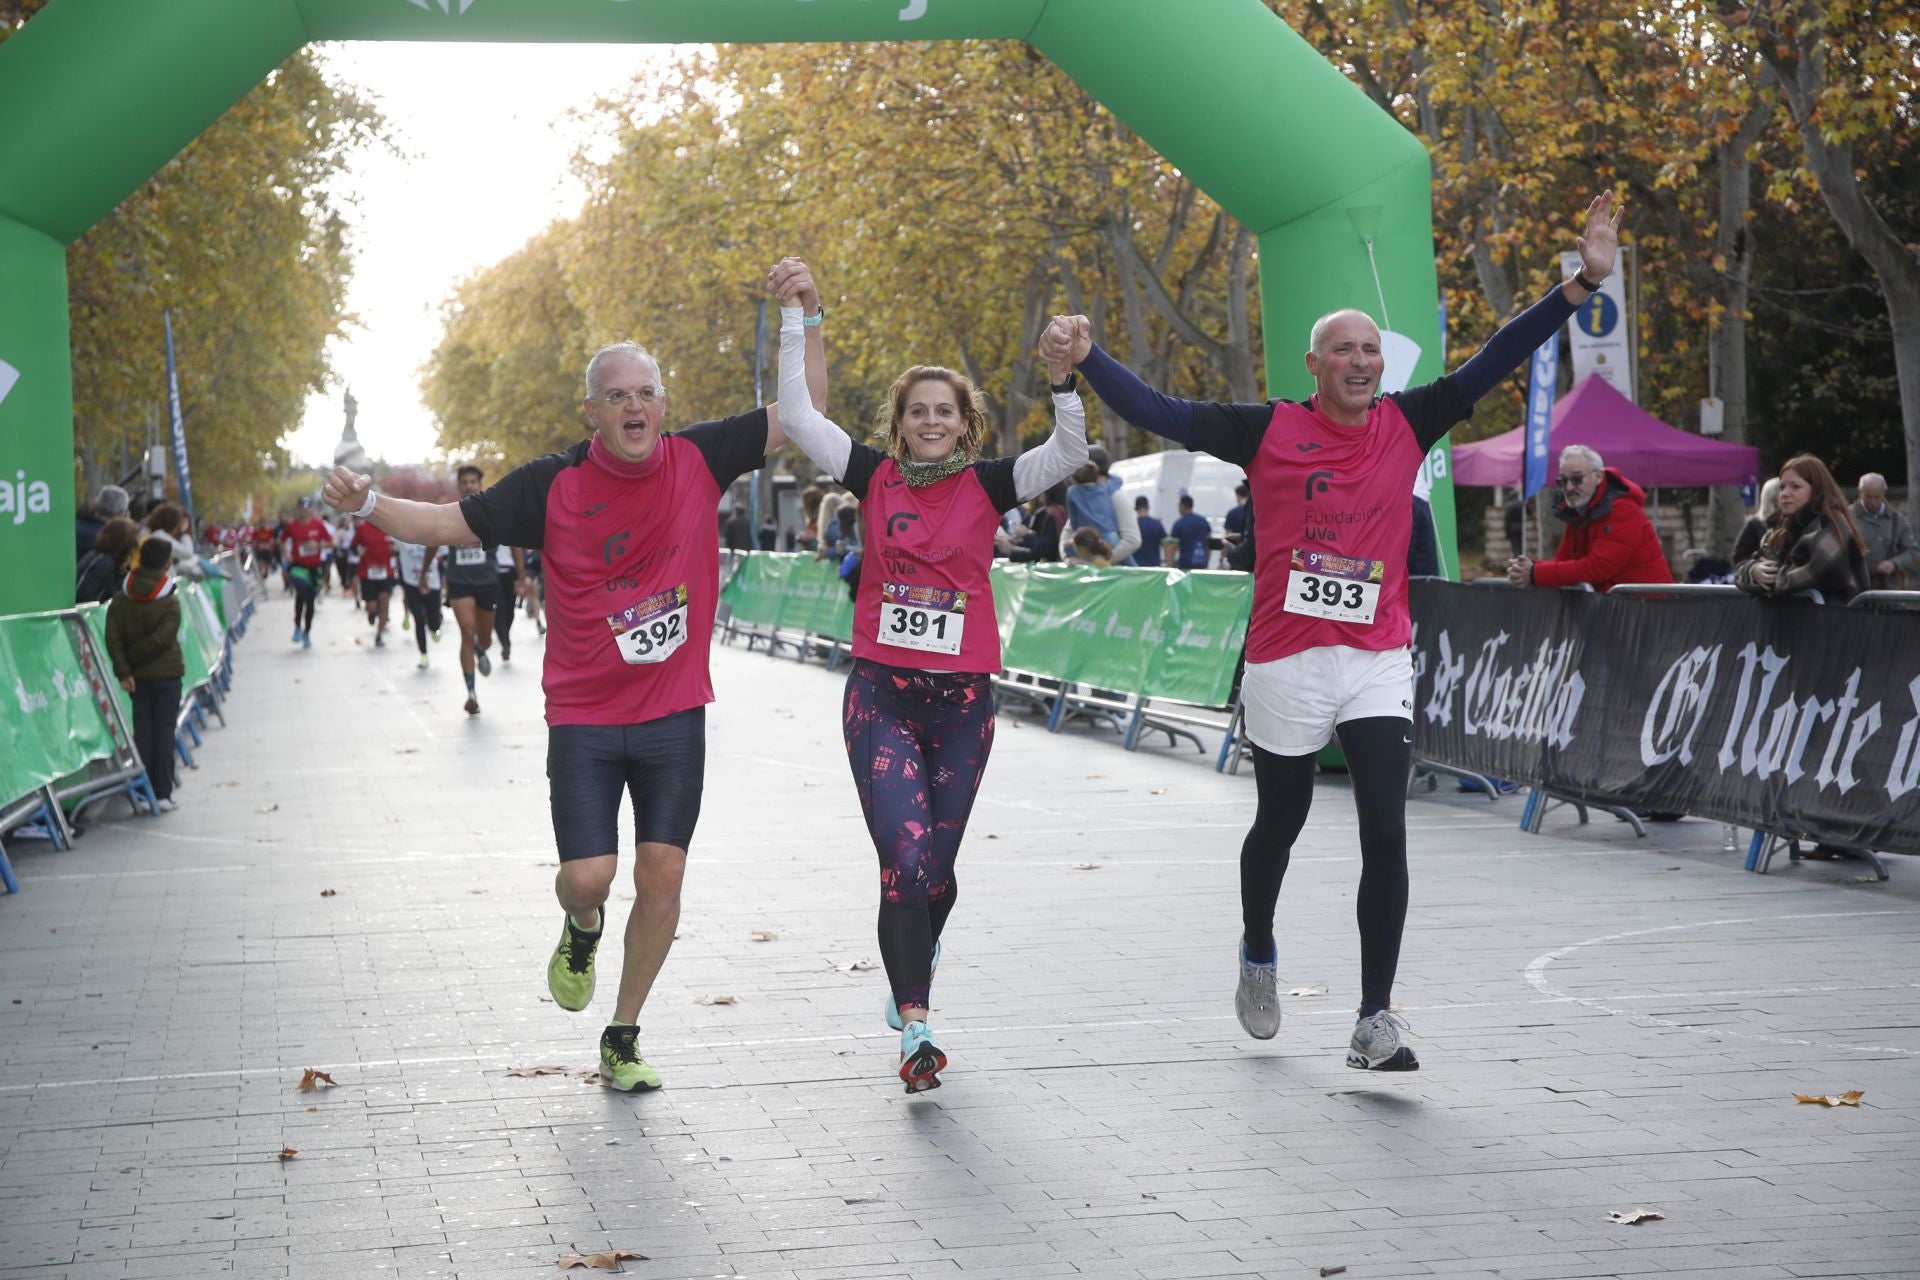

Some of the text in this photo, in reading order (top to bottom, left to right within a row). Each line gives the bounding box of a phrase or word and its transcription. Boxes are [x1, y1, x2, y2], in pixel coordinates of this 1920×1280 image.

[1305, 505, 1384, 524] Fundación
[1305, 527, 1336, 540] UVa
[1300, 576, 1364, 609] 393
[630, 613, 680, 656] 392
[890, 607, 947, 640] 391
[1640, 642, 1723, 768] El
[1717, 640, 1883, 796] Norte
